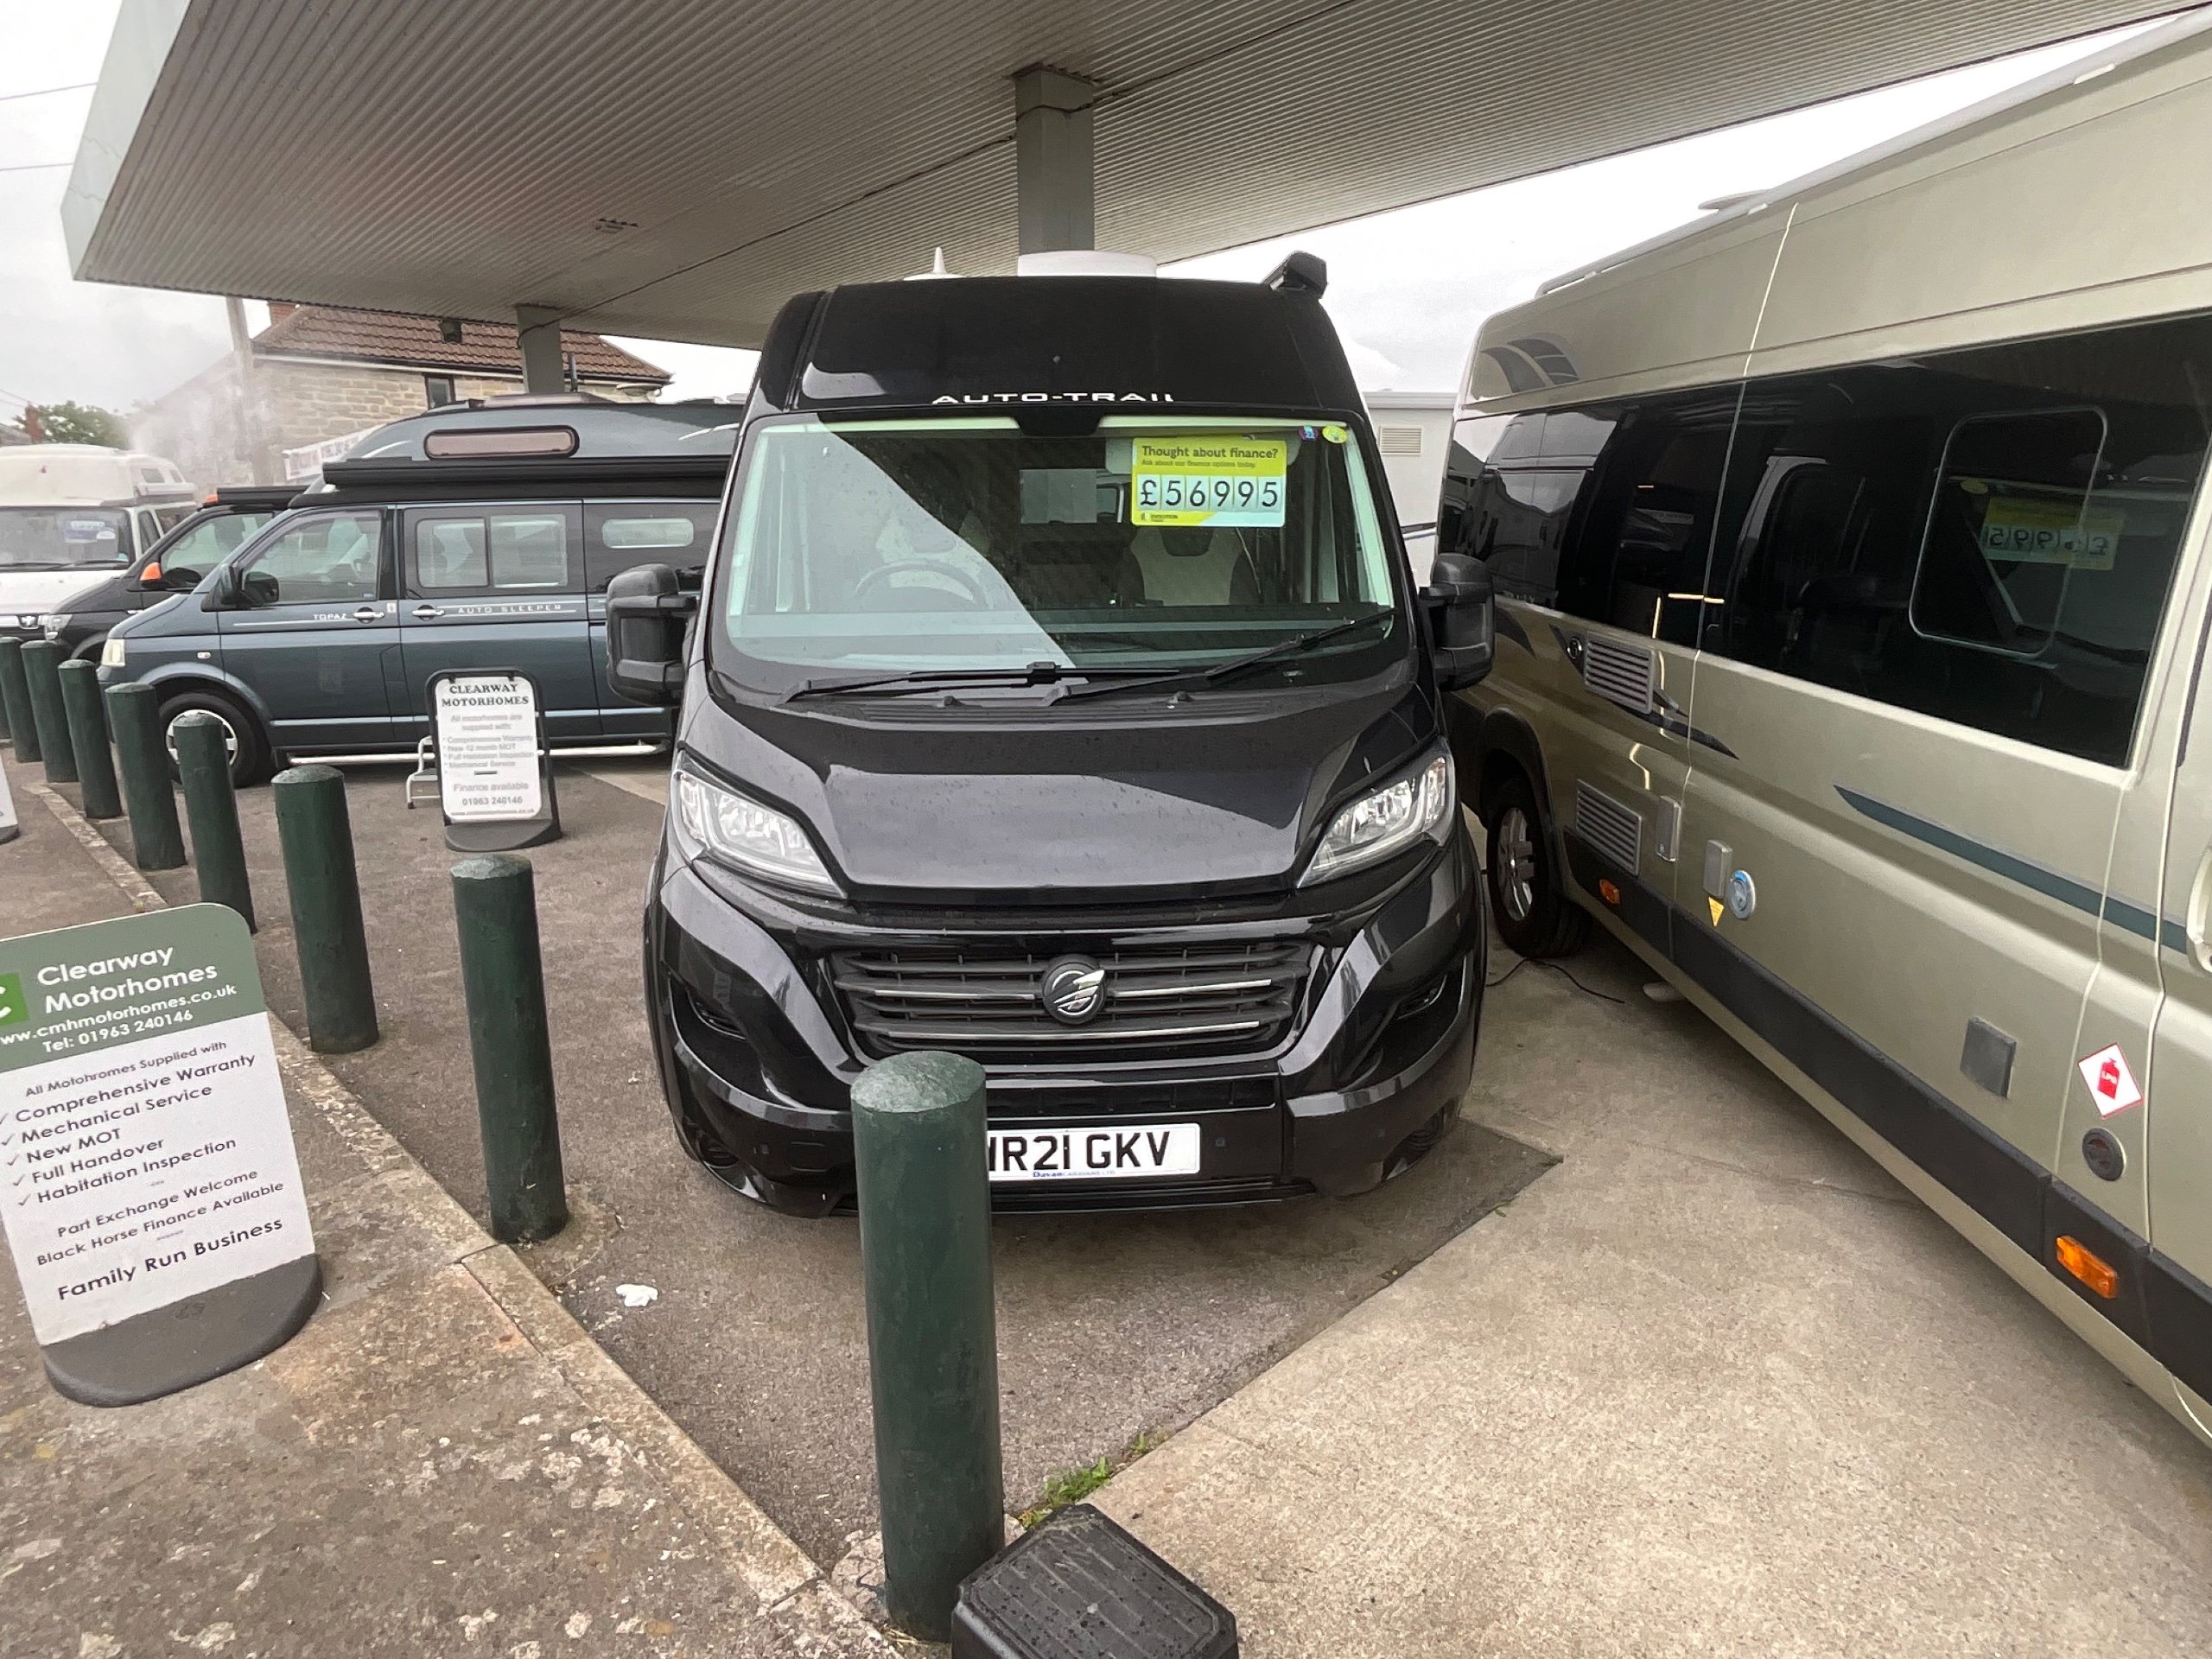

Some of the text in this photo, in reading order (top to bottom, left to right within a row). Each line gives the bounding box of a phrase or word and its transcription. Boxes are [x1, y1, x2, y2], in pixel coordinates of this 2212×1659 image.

[932, 392, 1174, 404] AUTO-TRAIL
[1142, 445, 1279, 459] Thought about finance?
[1141, 480, 1279, 507] £56995
[313, 613, 346, 621] TOPAZ
[457, 604, 562, 615] AUTO SLEEPER
[442, 696, 530, 708] MOTORHOMES
[449, 683, 518, 695] CLEARWAY
[453, 783, 488, 792] Finance
[37, 947, 173, 986] Clearway
[45, 964, 218, 1014] Motorhomes
[0, 984, 237, 1046] ww.cmhmotorhomes.co.uk
[43, 1009, 194, 1053] Tel: 01963 240146
[16, 1054, 256, 1122] Comprehensive Warranty
[25, 1085, 43, 1097] All
[140, 1046, 198, 1070] Supplied
[200, 1040, 227, 1054] with
[22, 1085, 213, 1144] Mechanical Service
[27, 1128, 122, 1163] New MOT
[32, 1137, 165, 1184] Full Handover
[1086, 1130, 1171, 1169] GKV
[38, 1138, 237, 1204] Habitation Inspection
[57, 1168, 258, 1238] Part Exchange Welcome
[37, 1181, 284, 1267] Black Horse Finance Available
[58, 1217, 283, 1301] Family Run Business
